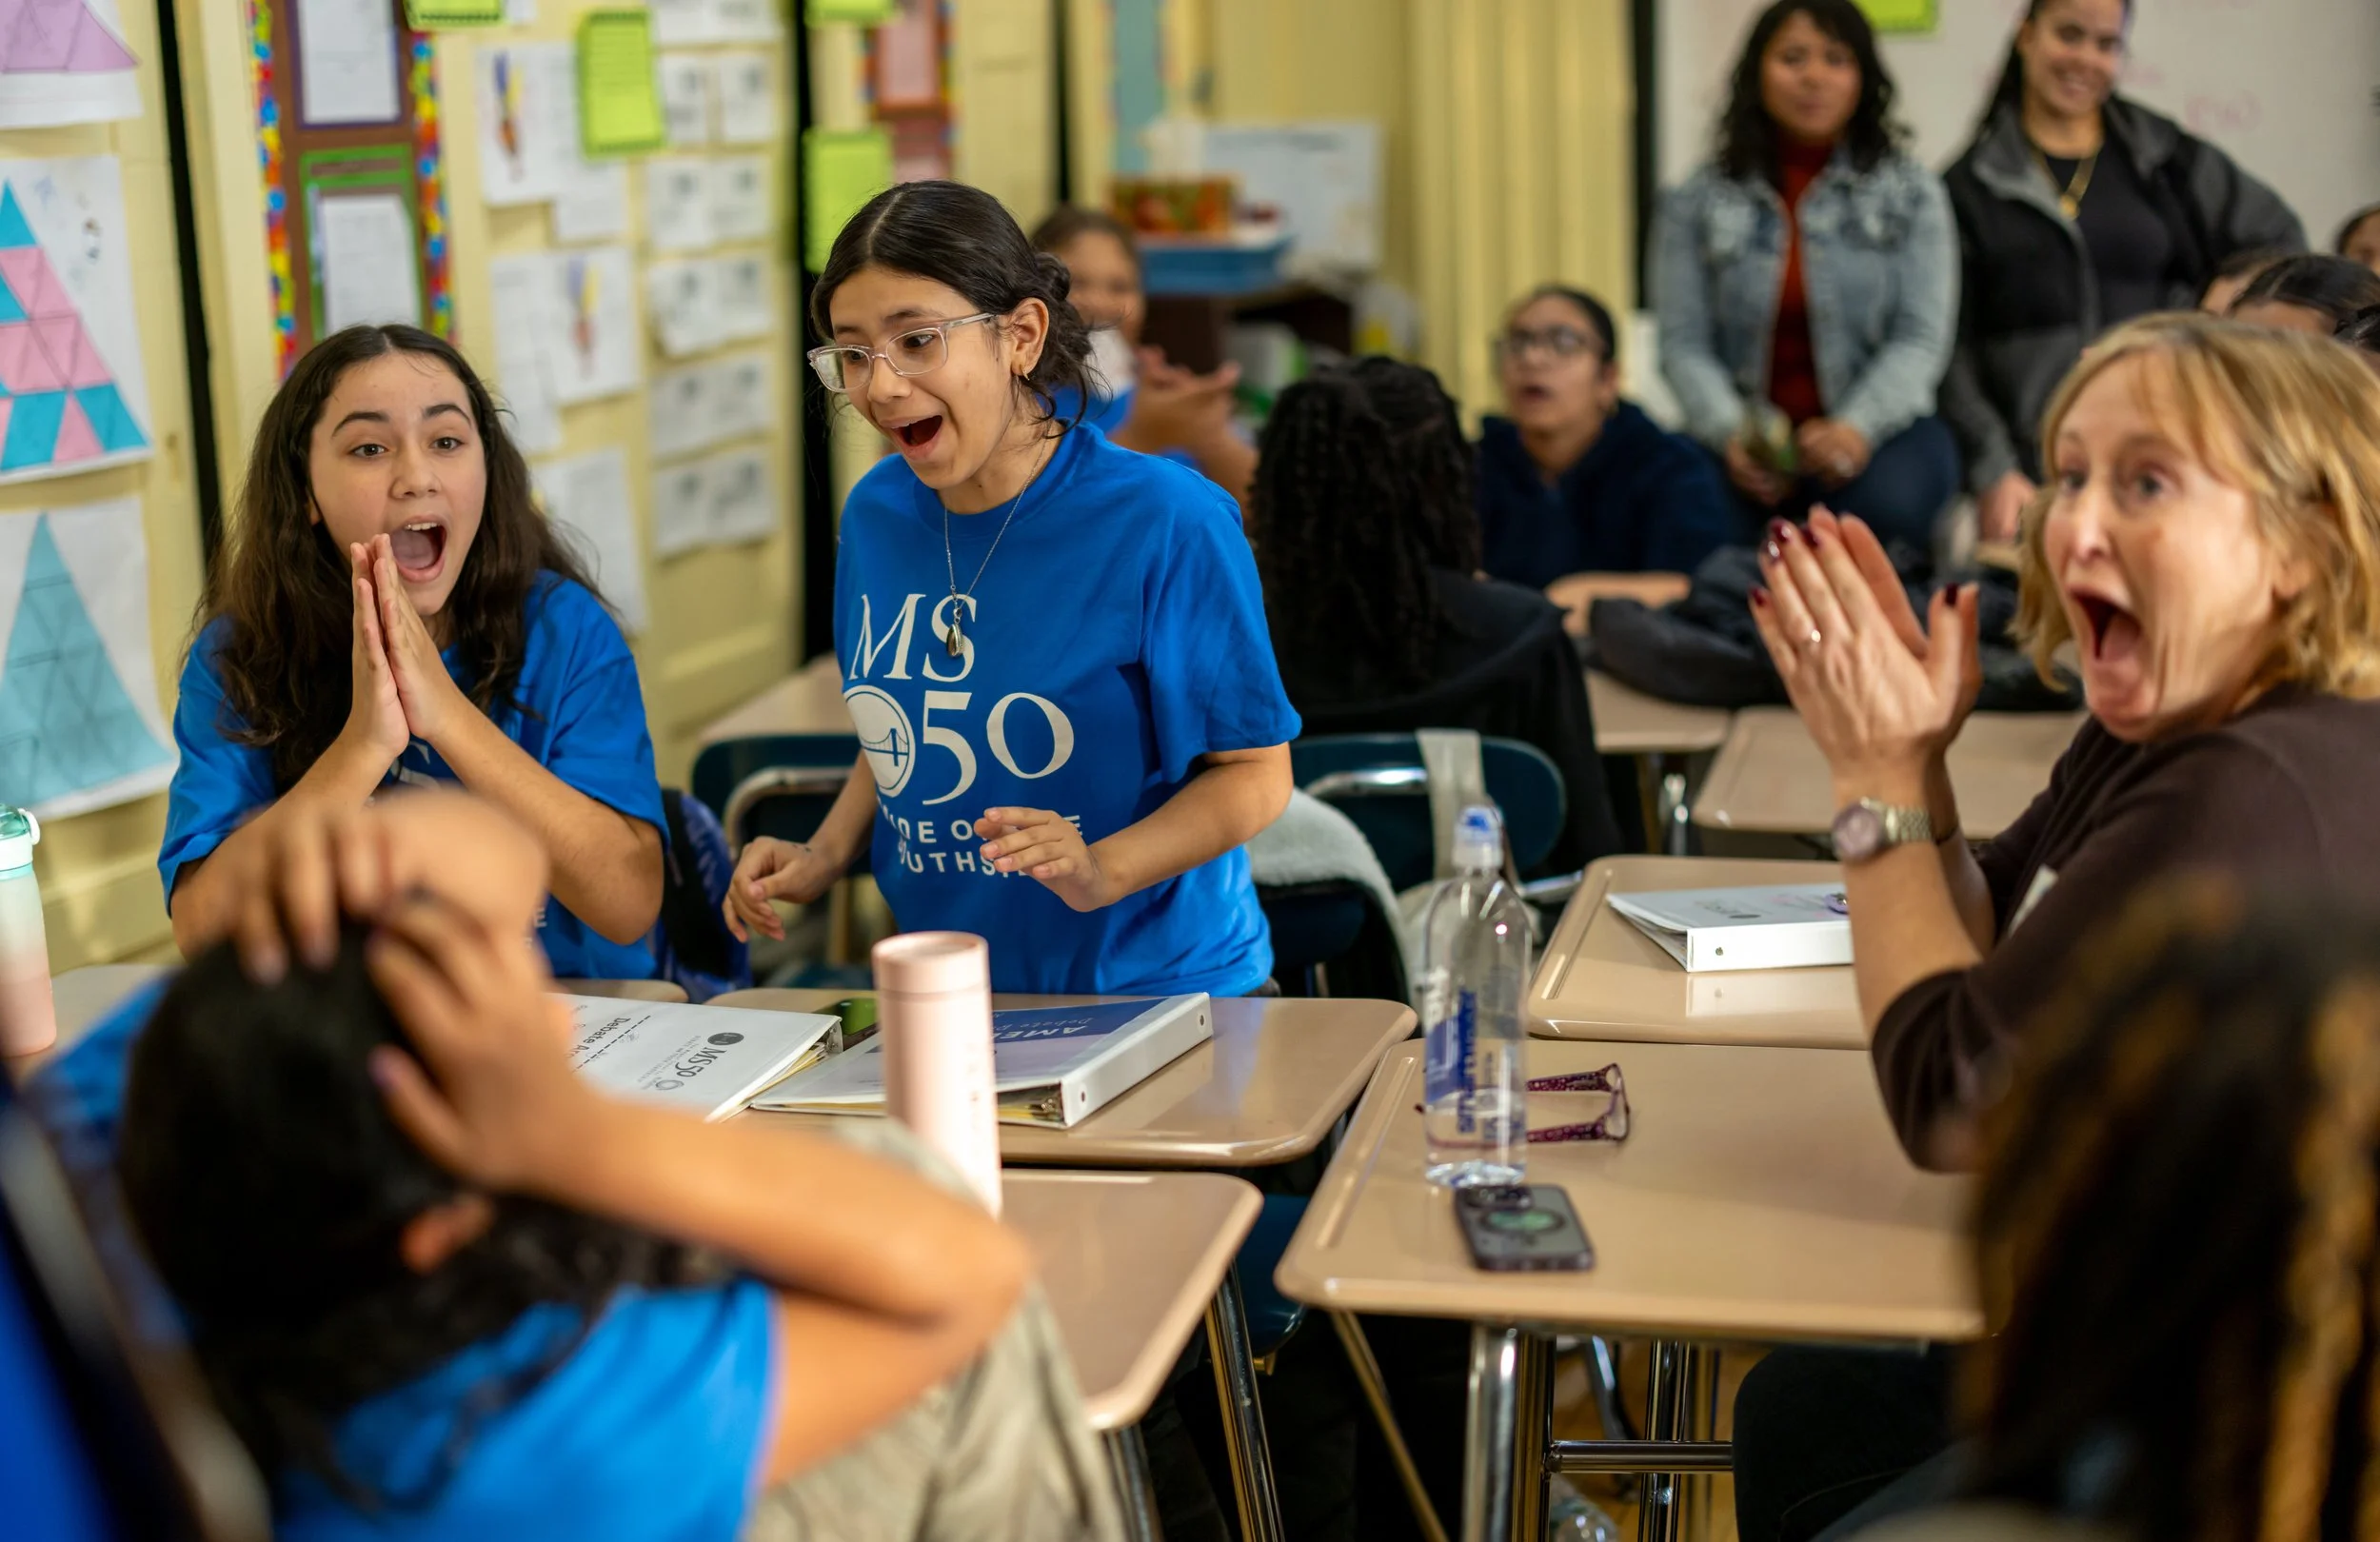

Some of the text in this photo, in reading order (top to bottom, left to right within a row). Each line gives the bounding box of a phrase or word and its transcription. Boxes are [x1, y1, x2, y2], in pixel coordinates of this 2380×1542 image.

[848, 593, 978, 682] MS
[922, 689, 1075, 806] 50
[583, 1018, 631, 1044] Debate
